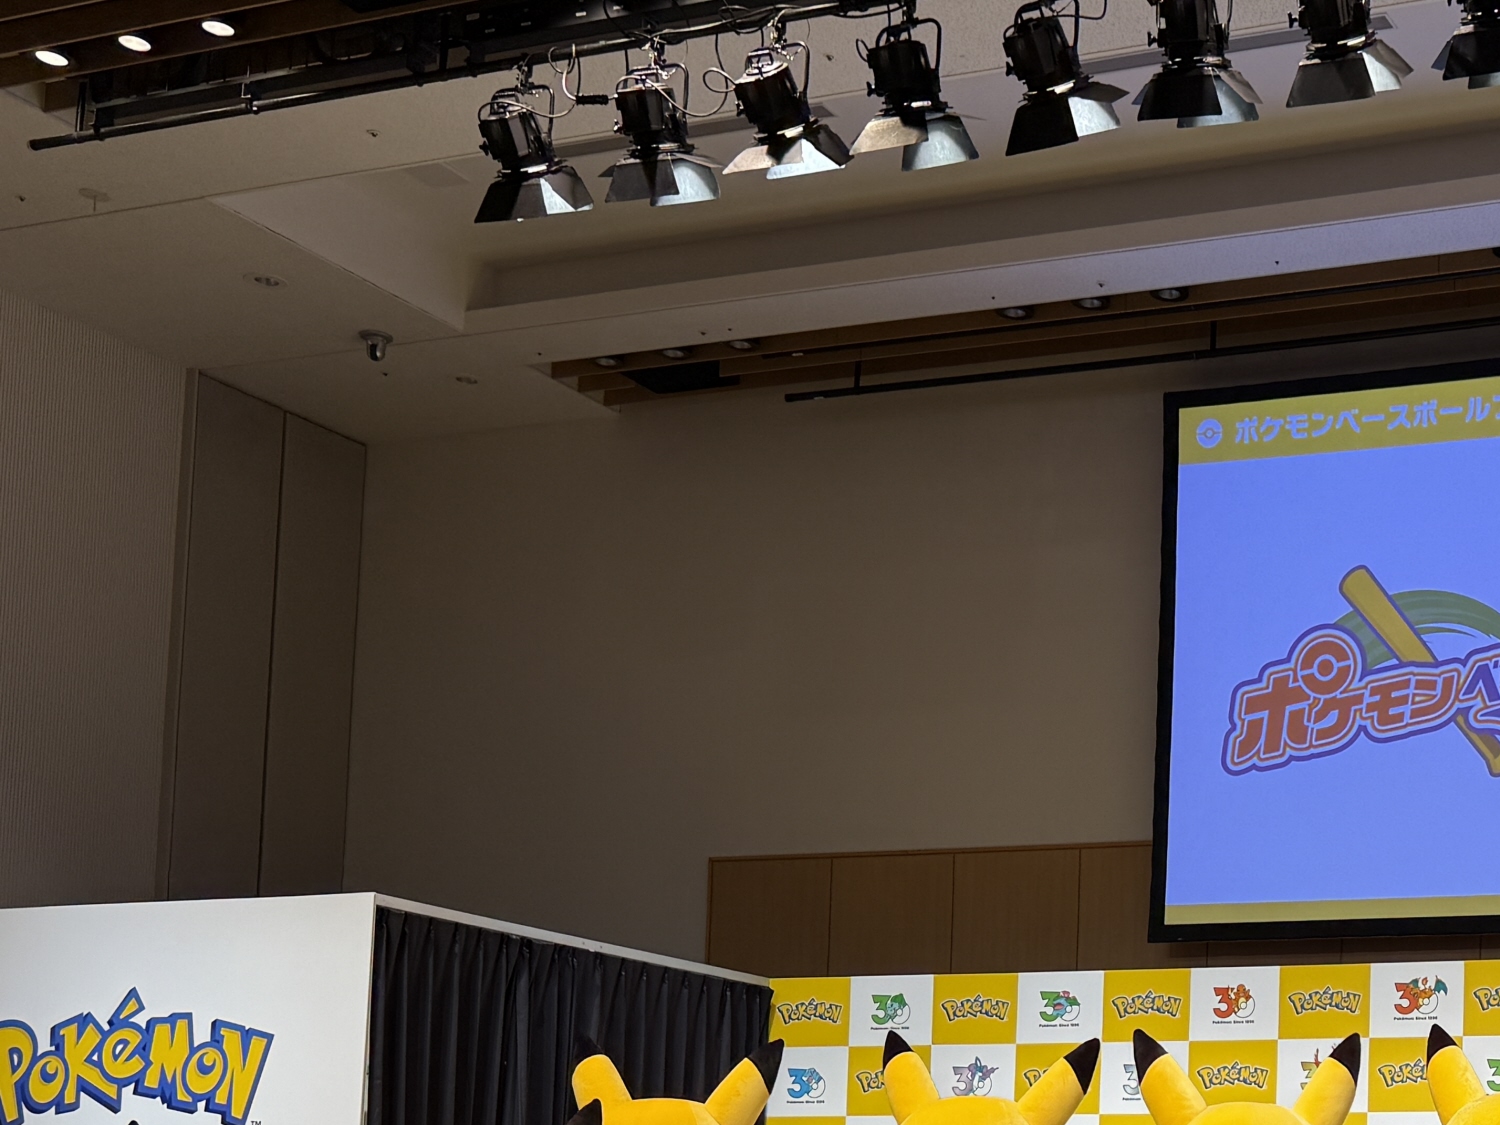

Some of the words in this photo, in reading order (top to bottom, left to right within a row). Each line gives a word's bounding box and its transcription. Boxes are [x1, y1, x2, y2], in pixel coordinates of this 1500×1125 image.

[776, 998, 842, 1024] Pokémon
[941, 995, 1008, 1022] Pokémon
[1111, 990, 1182, 1018] Pokémon
[1288, 986, 1361, 1015] Pokémon
[1196, 1062, 1269, 1089] Pokémon
[1378, 1059, 1427, 1087] Poké
